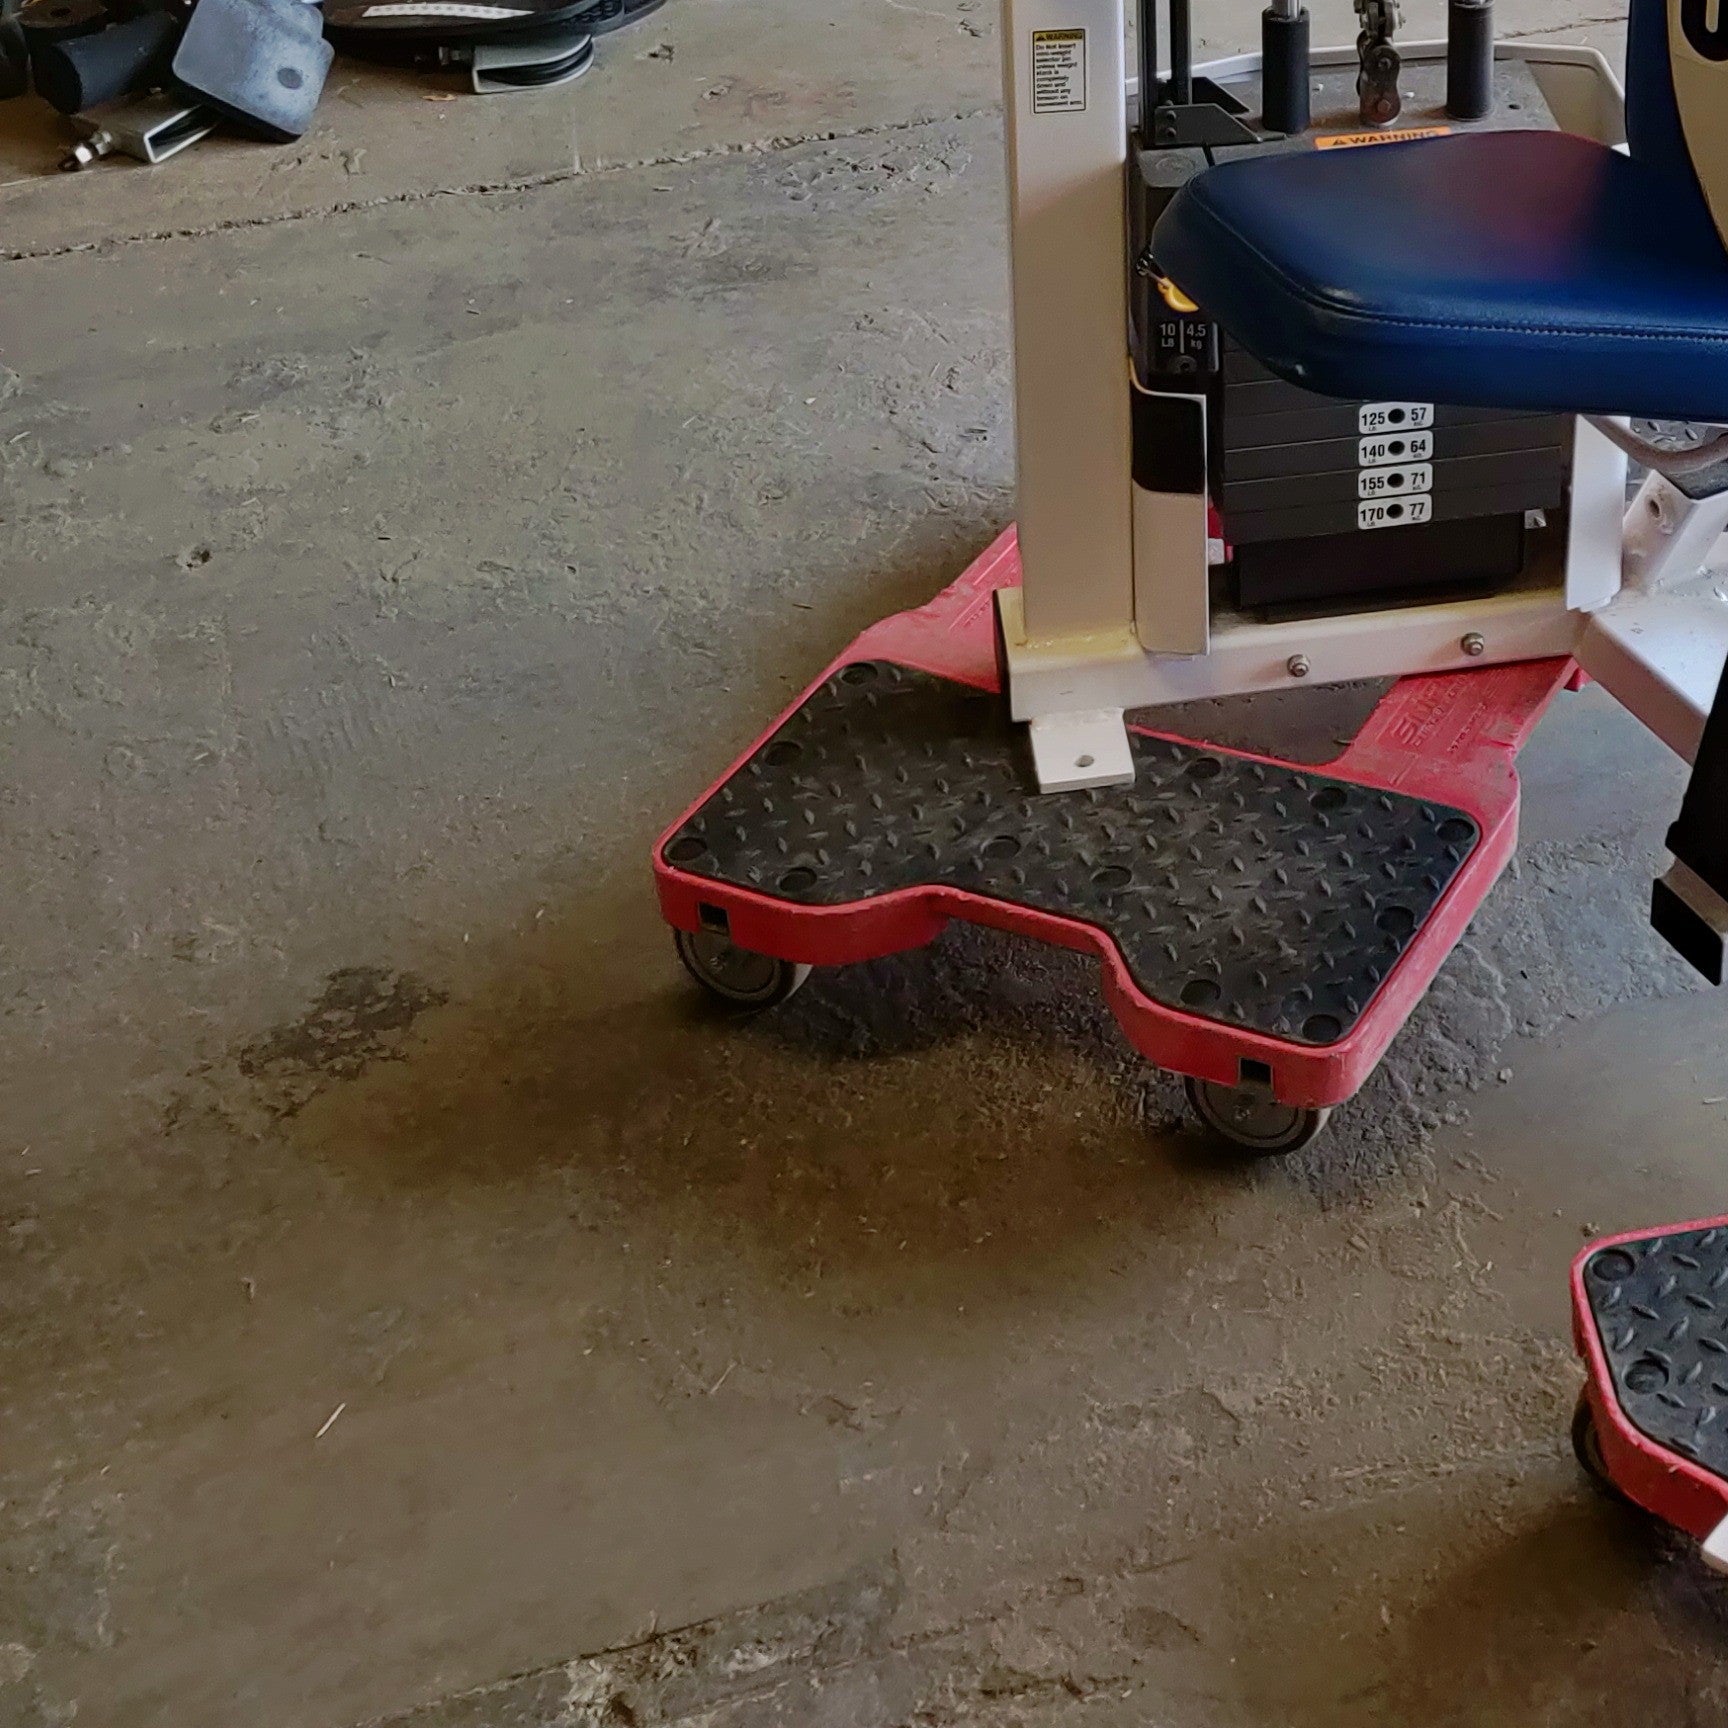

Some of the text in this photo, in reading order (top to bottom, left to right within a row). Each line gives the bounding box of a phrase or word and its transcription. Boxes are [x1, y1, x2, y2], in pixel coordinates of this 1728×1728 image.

[1160, 324, 1206, 337] 10 4.5
[1162, 338, 1202, 349] LB kg
[1362, 407, 1426, 426] 125 57
[1362, 439, 1425, 458] 140 64
[1361, 471, 1425, 491] 155 71
[1360, 502, 1425, 522] 170 77
